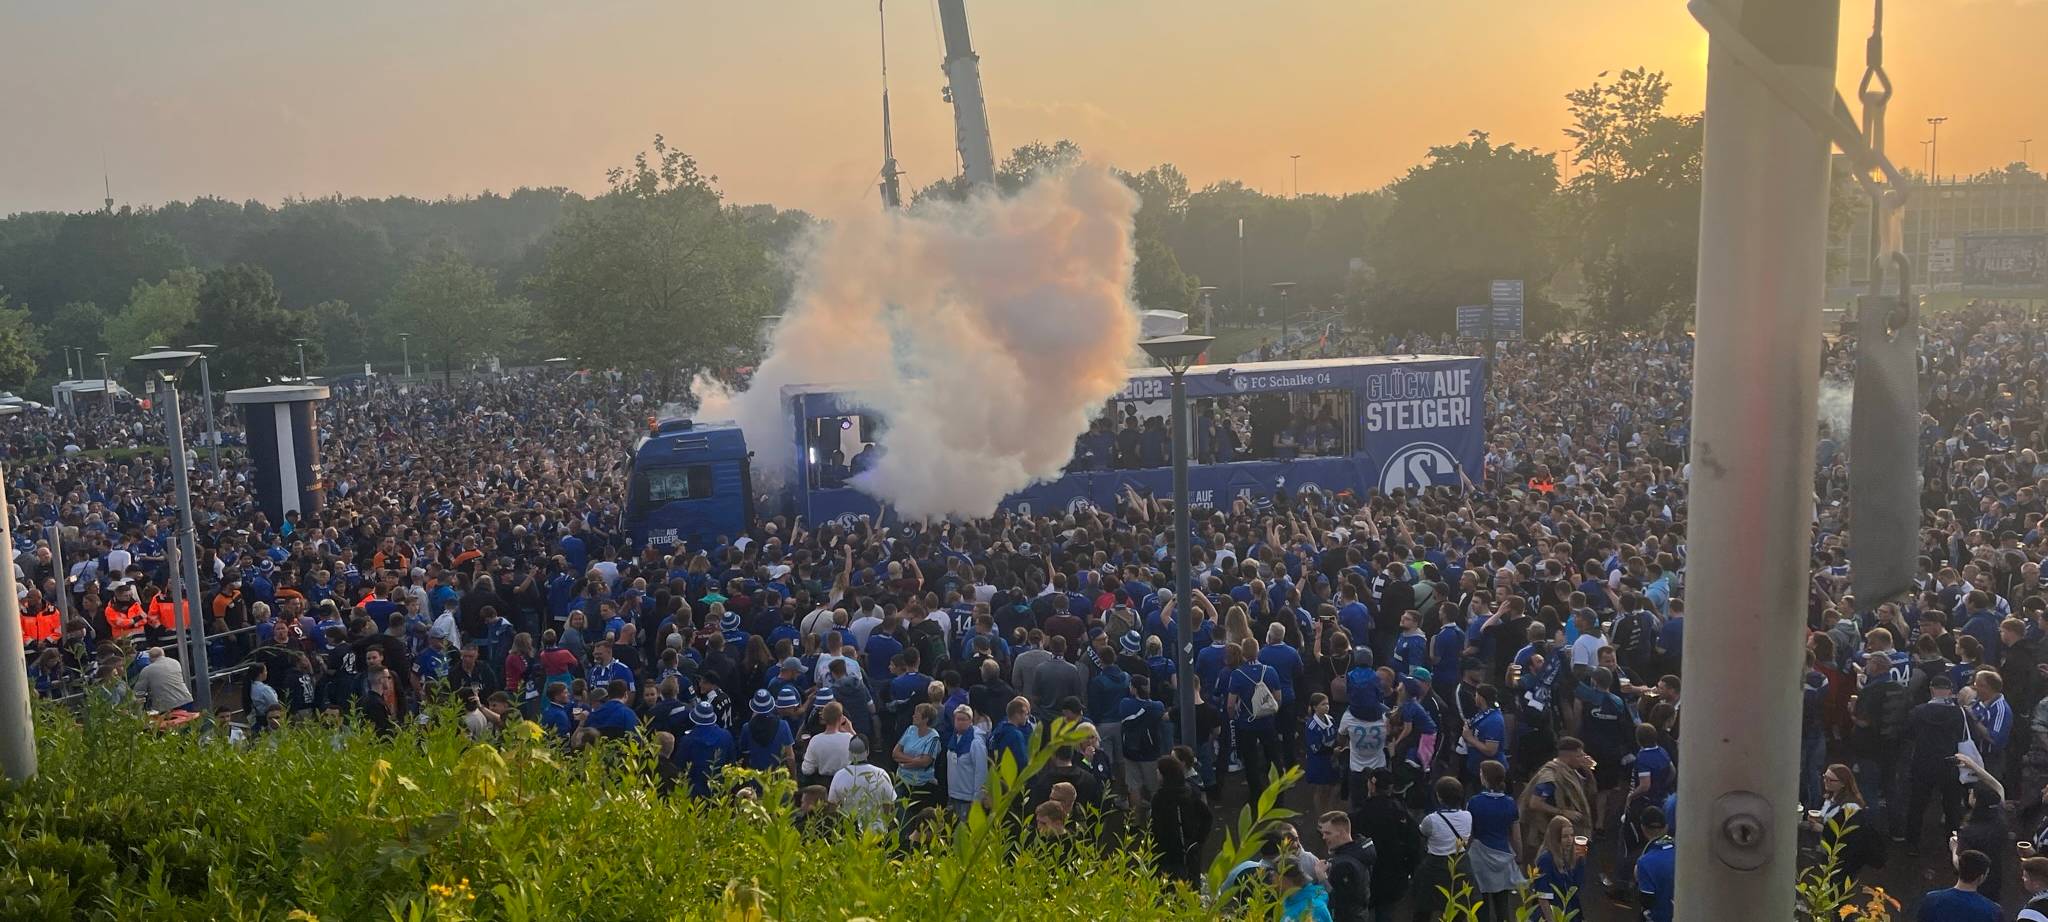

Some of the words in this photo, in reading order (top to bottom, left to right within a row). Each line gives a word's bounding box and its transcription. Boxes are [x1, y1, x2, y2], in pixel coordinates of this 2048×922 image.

[1123, 380, 1163, 399] 2022
[1251, 376, 1266, 389] FC
[1269, 374, 1314, 388] Schalke
[1317, 373, 1331, 384] 04
[1367, 368, 1430, 401] GLÜCK
[1433, 369, 1470, 397] AUF
[1367, 397, 1470, 432] STEIGER!
[1196, 489, 1214, 503] AUF
[955, 615, 972, 634] 14
